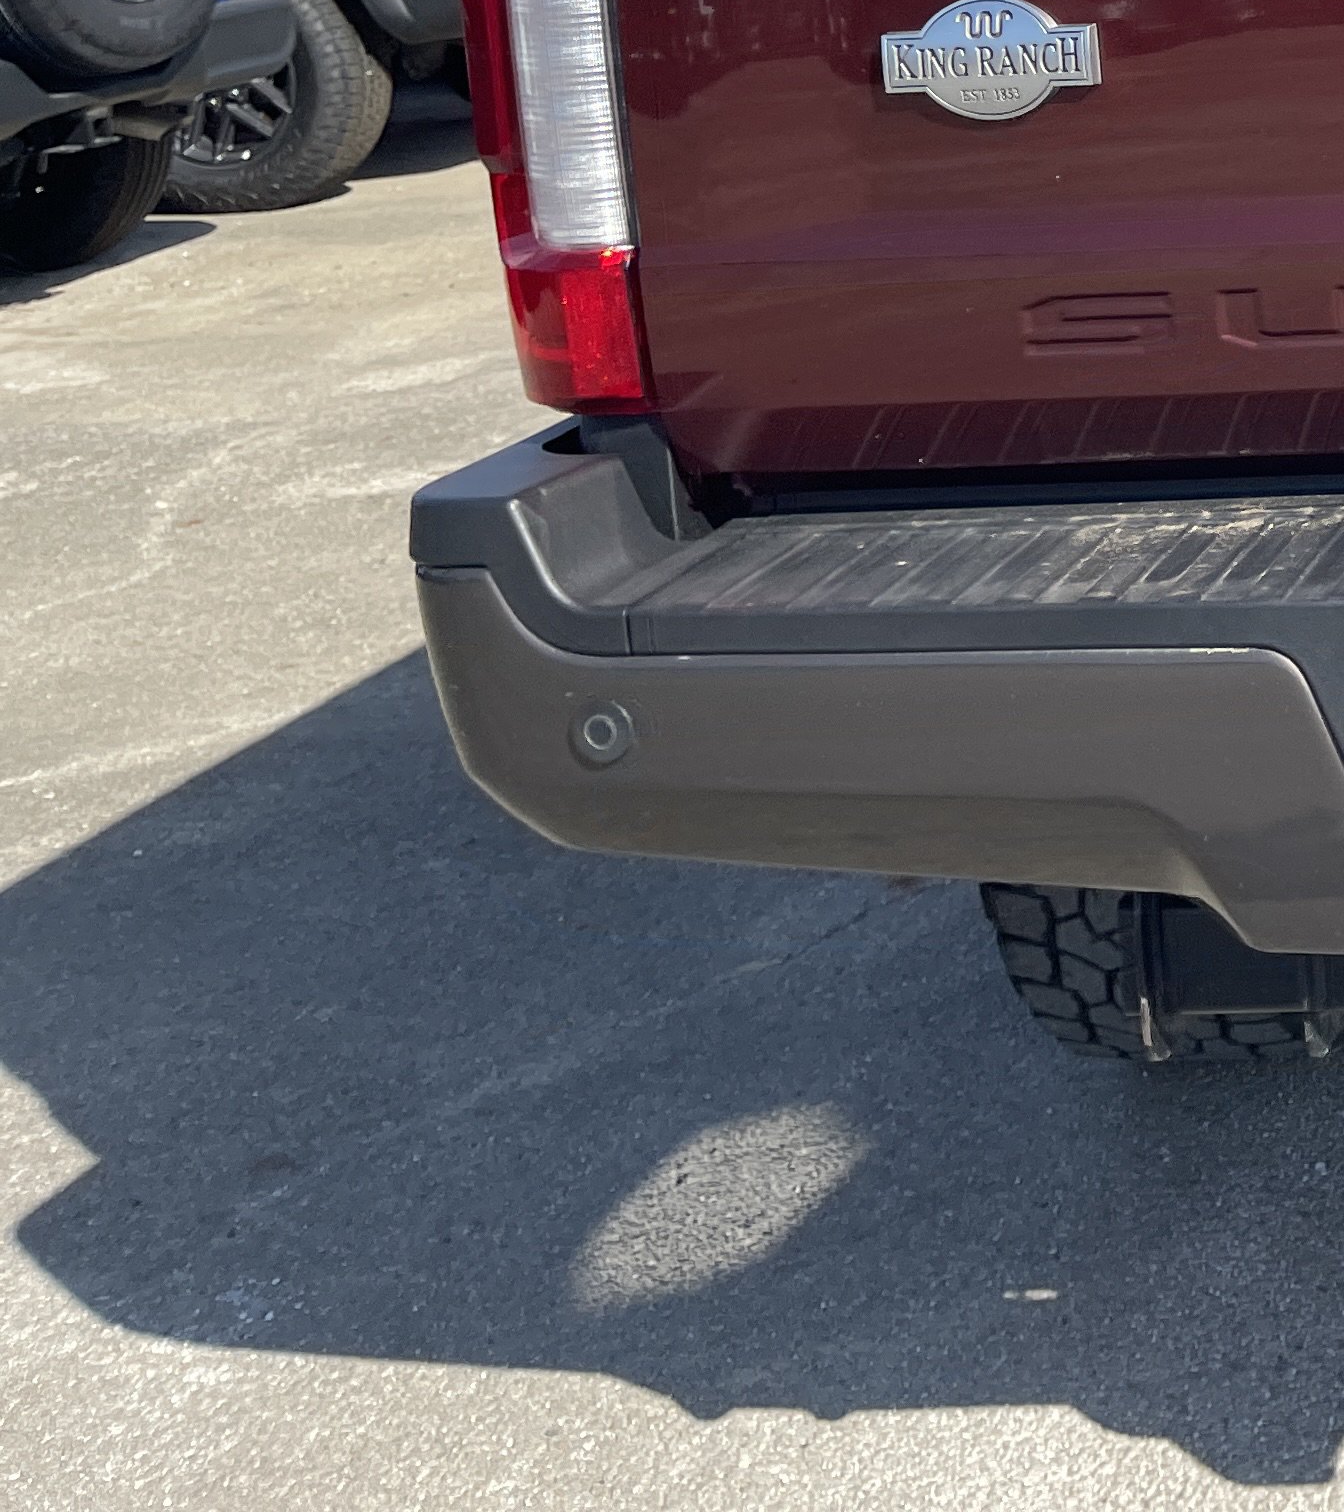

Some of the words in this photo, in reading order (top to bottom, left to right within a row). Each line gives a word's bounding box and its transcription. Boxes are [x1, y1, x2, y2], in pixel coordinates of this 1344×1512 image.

[891, 43, 969, 81] KING
[974, 36, 1082, 78] RANCH
[959, 88, 987, 104] EST
[992, 87, 1021, 102] 1853
